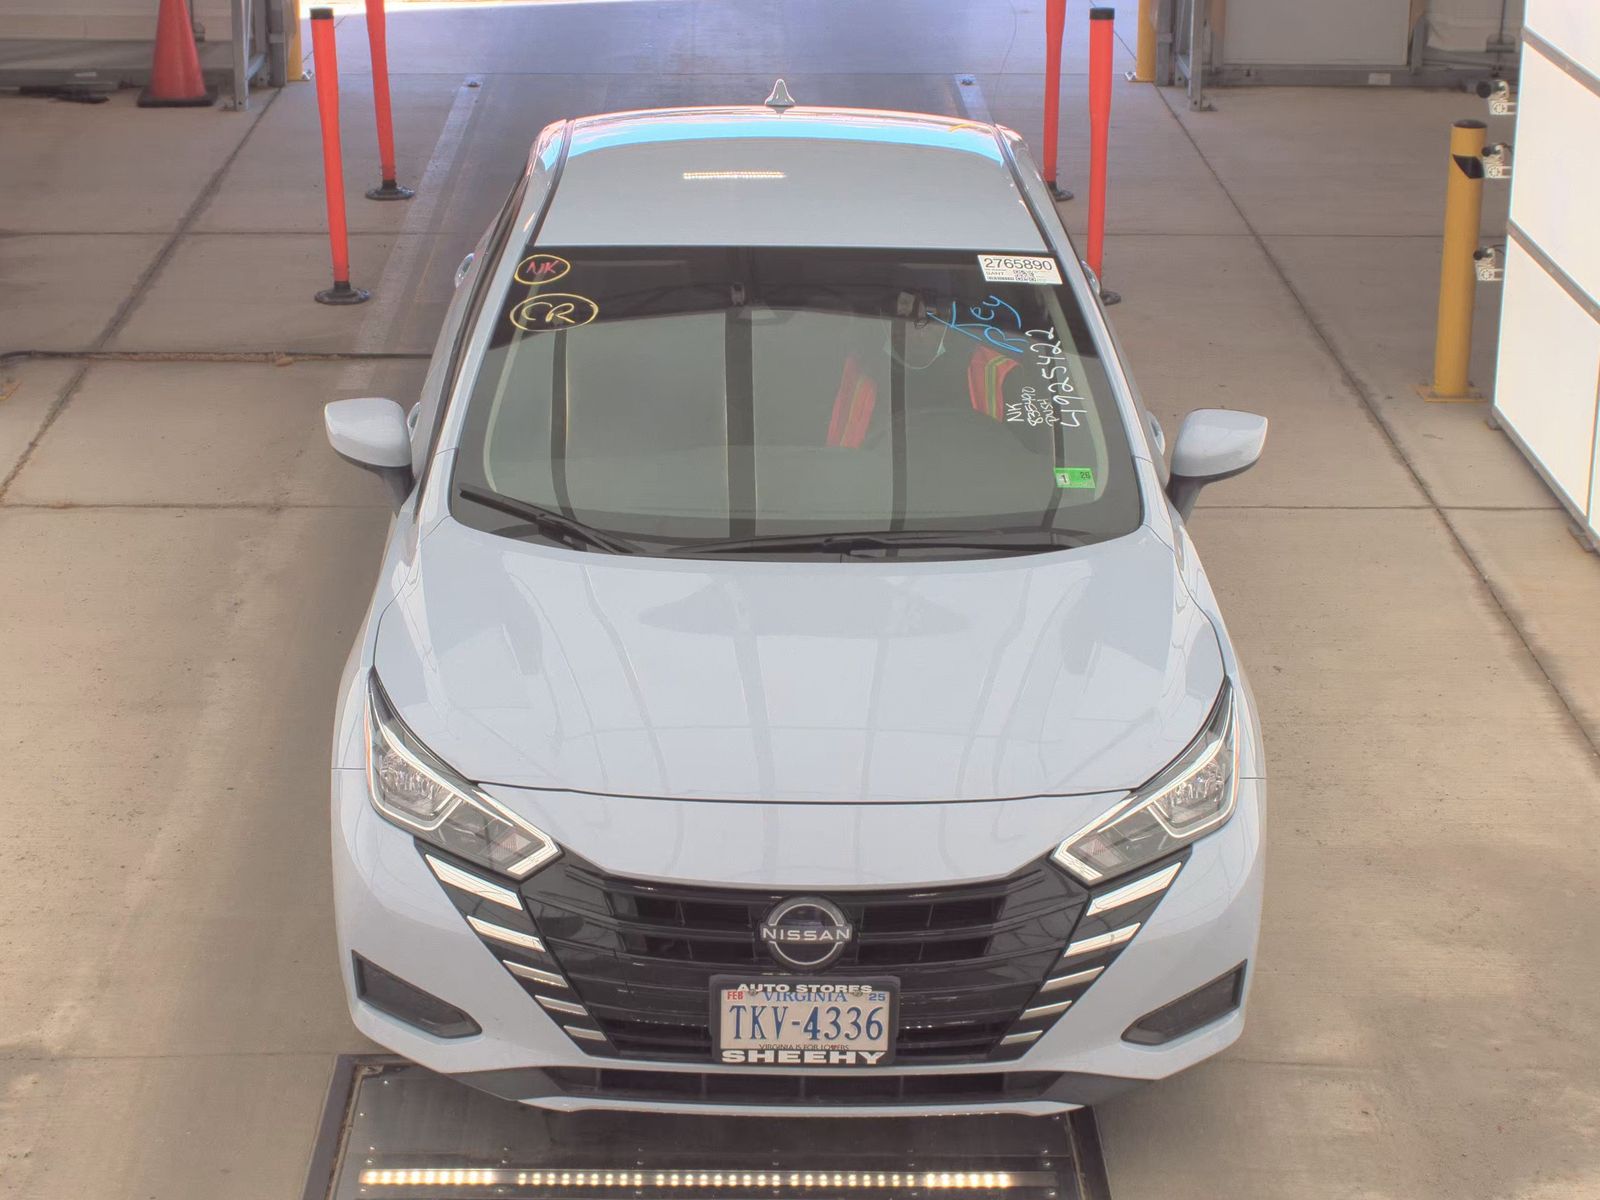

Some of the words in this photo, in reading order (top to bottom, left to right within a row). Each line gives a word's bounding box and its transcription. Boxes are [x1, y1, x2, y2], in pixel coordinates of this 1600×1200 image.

[984, 257, 1053, 271] 2765890
[1025, 326, 1088, 427] 4925422
[762, 927, 850, 941] NISSAN
[737, 983, 792, 993] AUTO
[795, 984, 873, 994] STORES
[727, 991, 744, 1000] FEB
[763, 991, 848, 1002] VIRGINIA
[868, 993, 886, 1001] 25
[729, 1005, 884, 1041] TKV-4336
[803, 1043, 819, 1051] FOR
[721, 1050, 886, 1065] SHEEHY
